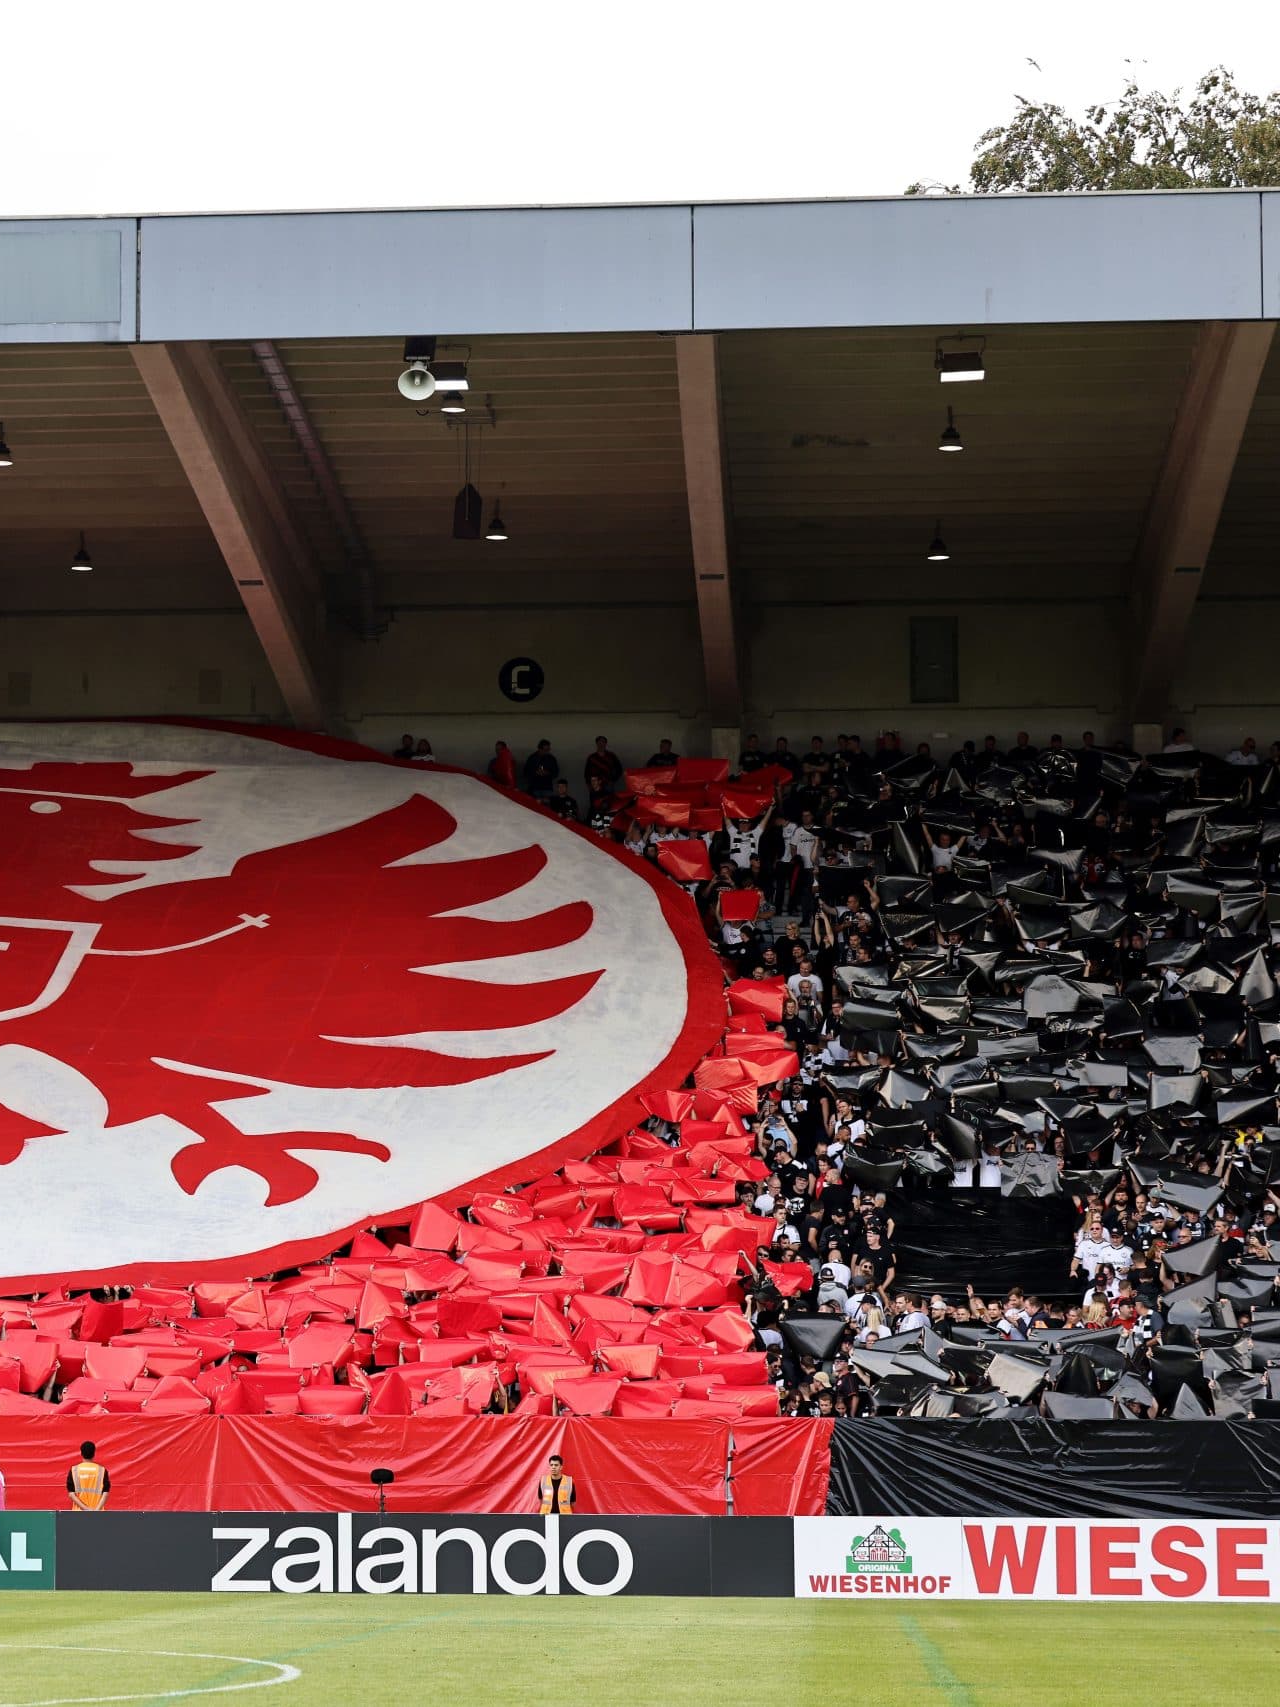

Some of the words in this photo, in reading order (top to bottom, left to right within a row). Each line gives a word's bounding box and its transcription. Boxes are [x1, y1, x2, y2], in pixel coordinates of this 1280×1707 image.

[511, 665, 530, 694] C
[212, 1513, 634, 1596] zalando
[858, 1564, 900, 1572] ORIGINAL
[963, 1525, 1270, 1597] WIESE
[809, 1575, 951, 1593] WIESENHOF
